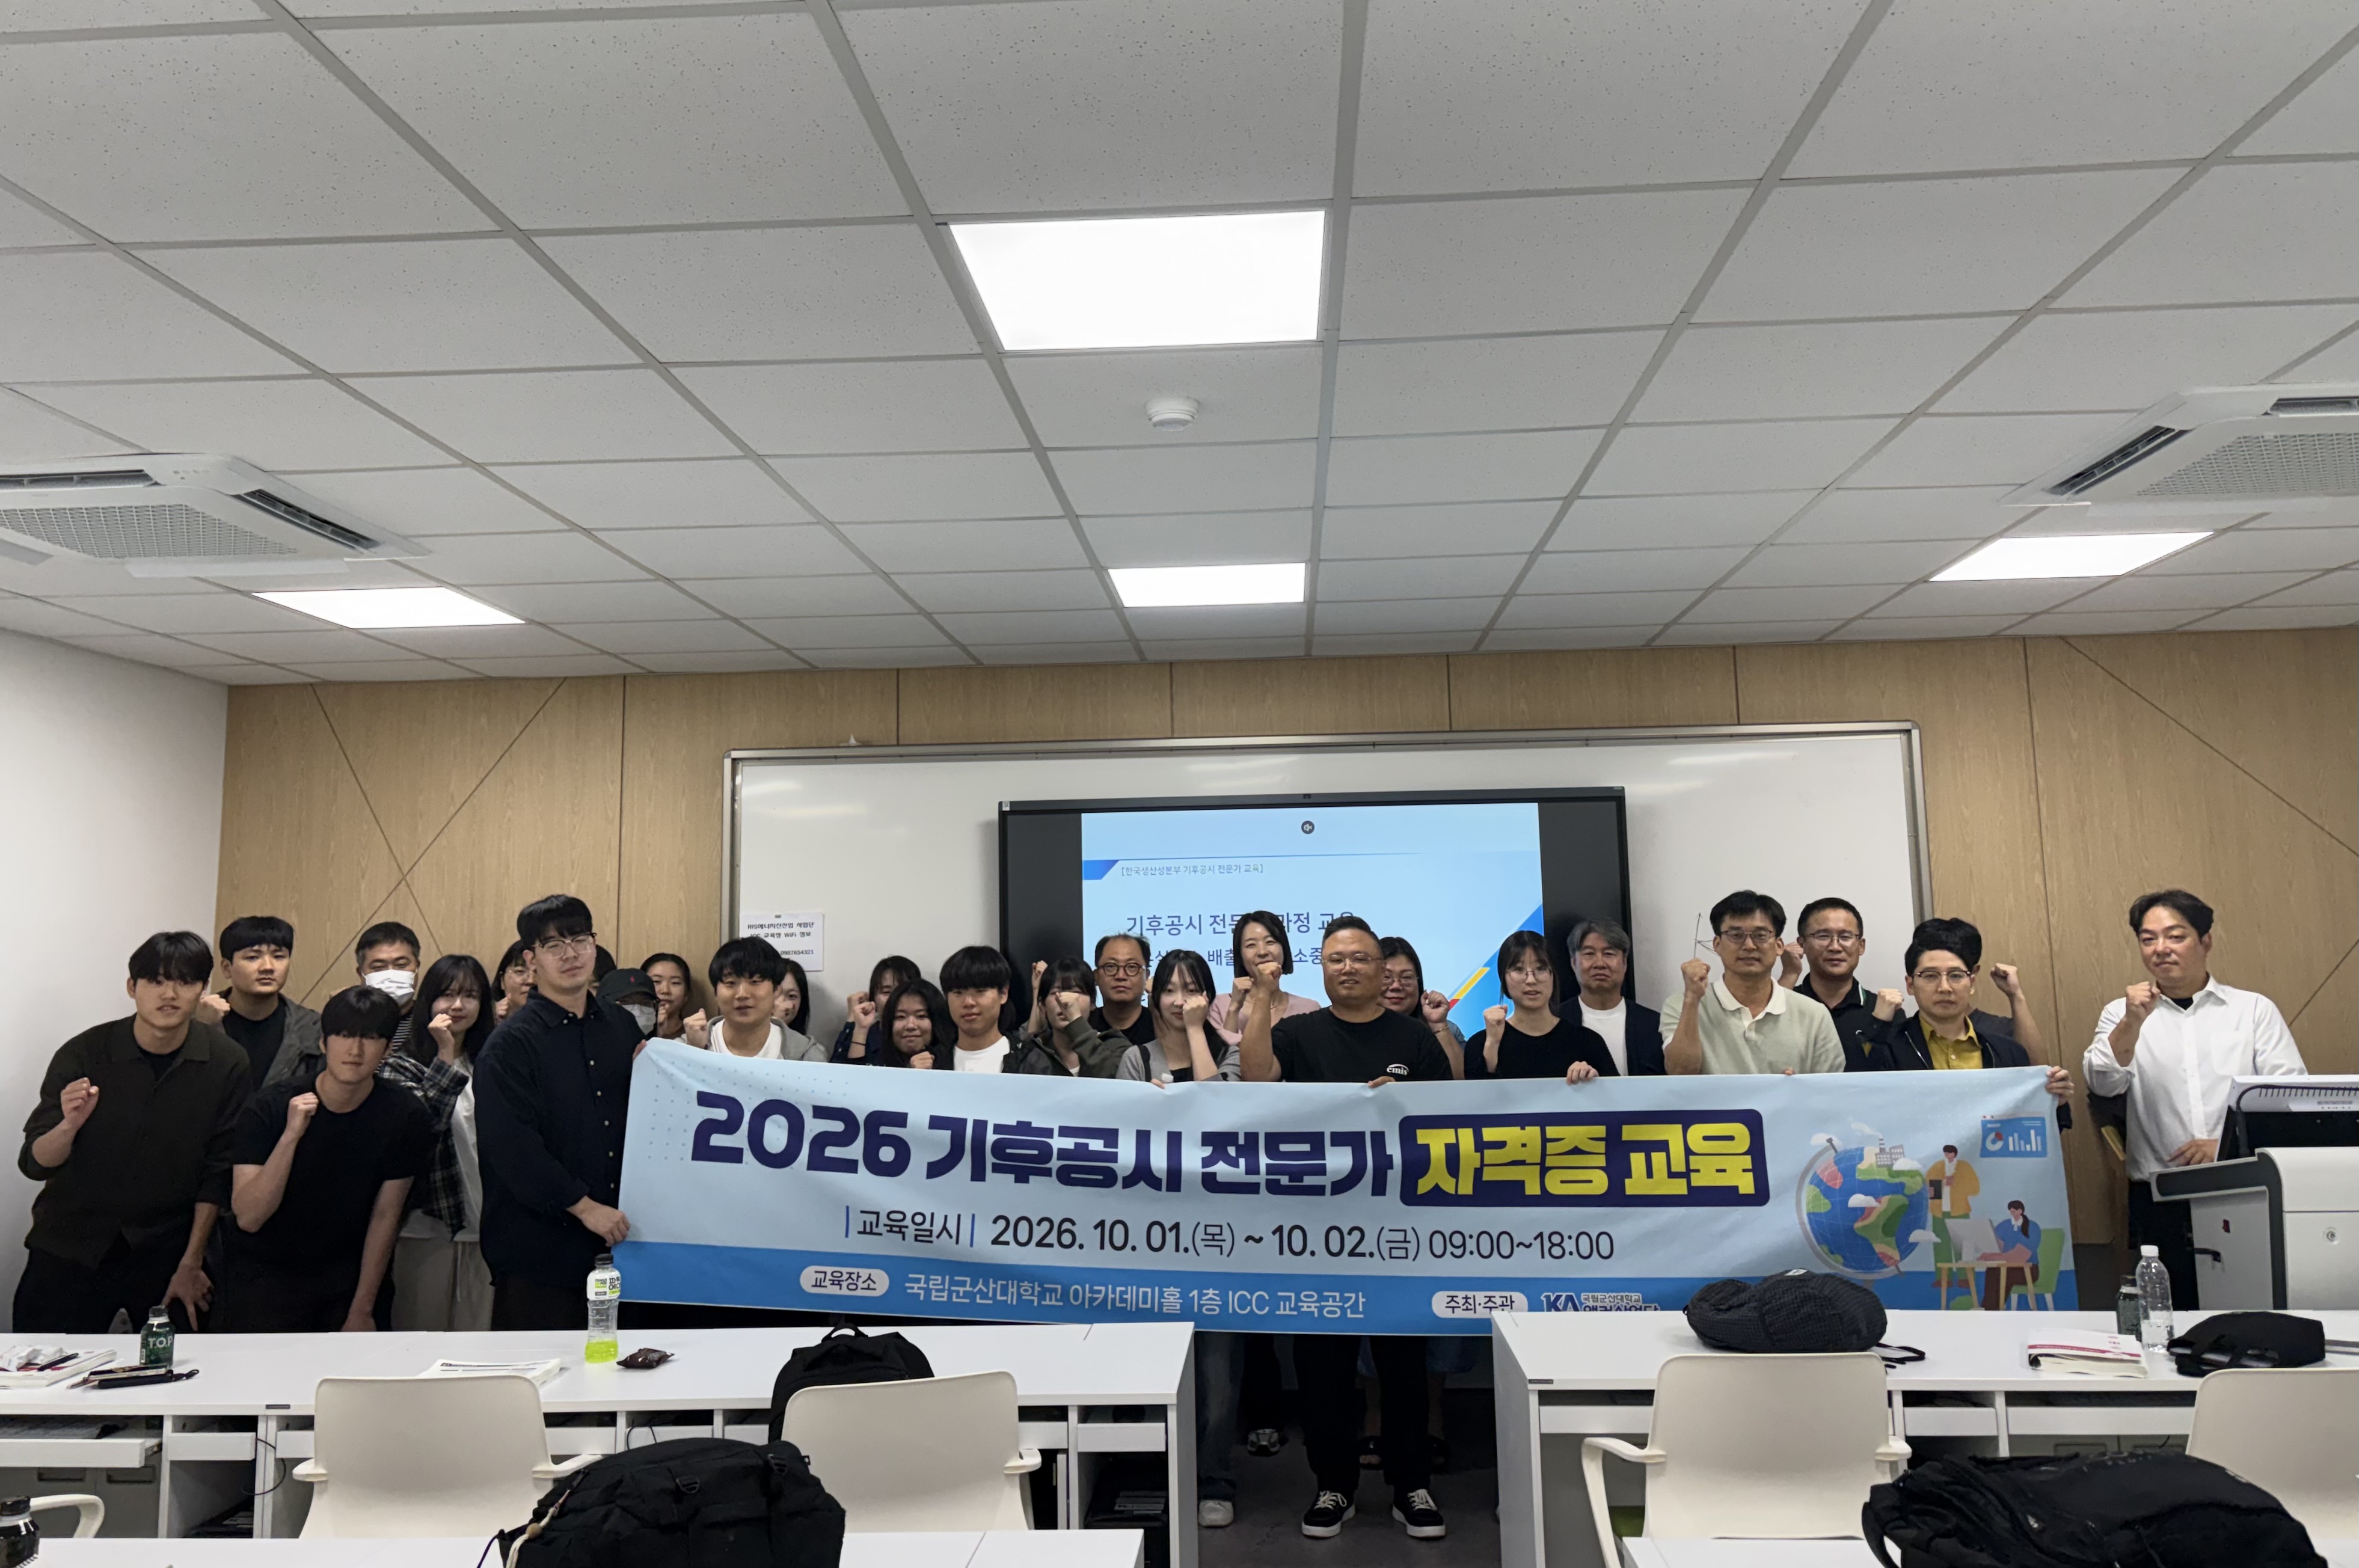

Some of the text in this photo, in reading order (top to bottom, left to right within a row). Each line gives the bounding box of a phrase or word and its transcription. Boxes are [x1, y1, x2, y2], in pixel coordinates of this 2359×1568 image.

[1121, 863, 1263, 876] [한국생산성본부 기후공시 전문가 교육]
[1127, 914, 1203, 935] 기후공시
[1207, 948, 1234, 966] 배출
[1386, 1067, 1408, 1076] emis
[691, 1090, 1755, 1196] 2026 기후공시 전문가 자격증 교육
[856, 1209, 962, 1245] 교육일시
[990, 1214, 1084, 1249] 2026.
[1093, 1219, 1137, 1252] 10.
[1429, 1230, 1615, 1260] 09:00~18:00
[811, 1270, 877, 1292] 교육장소
[904, 1273, 1366, 1318] 국립군산대학교 아카데미홀 1층 ICC 교육공간
[1582, 1294, 1641, 1303] 국립군산대학교
